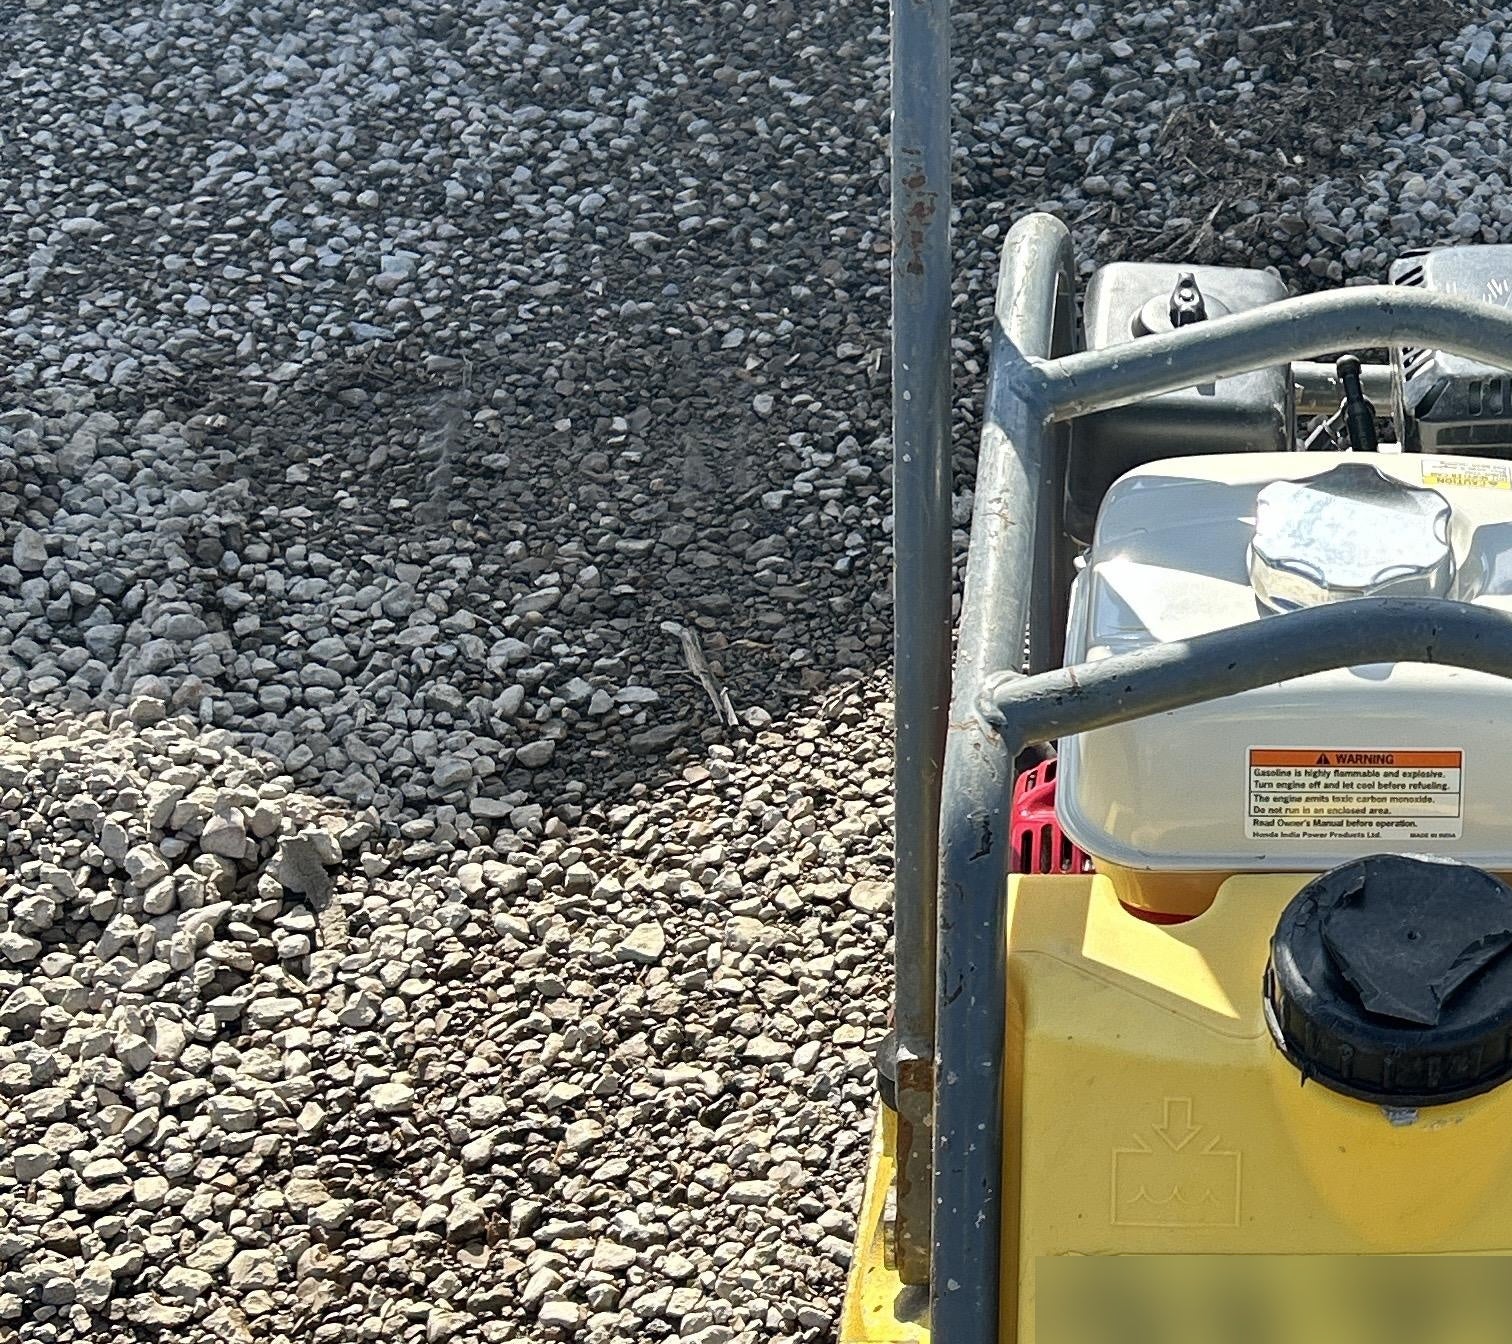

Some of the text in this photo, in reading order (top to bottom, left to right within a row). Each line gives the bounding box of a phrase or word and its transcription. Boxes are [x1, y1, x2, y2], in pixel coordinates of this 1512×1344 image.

[1335, 753, 1395, 765] WARNING
[1305, 769, 1331, 778] highly
[1334, 769, 1380, 777] flammable
[1402, 770, 1445, 779] explosive.
[1254, 780, 1450, 790] Turn engine off and let cool before refueling.
[1254, 794, 1270, 802] The
[1273, 795, 1302, 804] engine
[1356, 795, 1387, 803] carbon
[1303, 806, 1310, 814] in
[1277, 819, 1310, 827] Owner's
[1376, 820, 1417, 828] operation.
